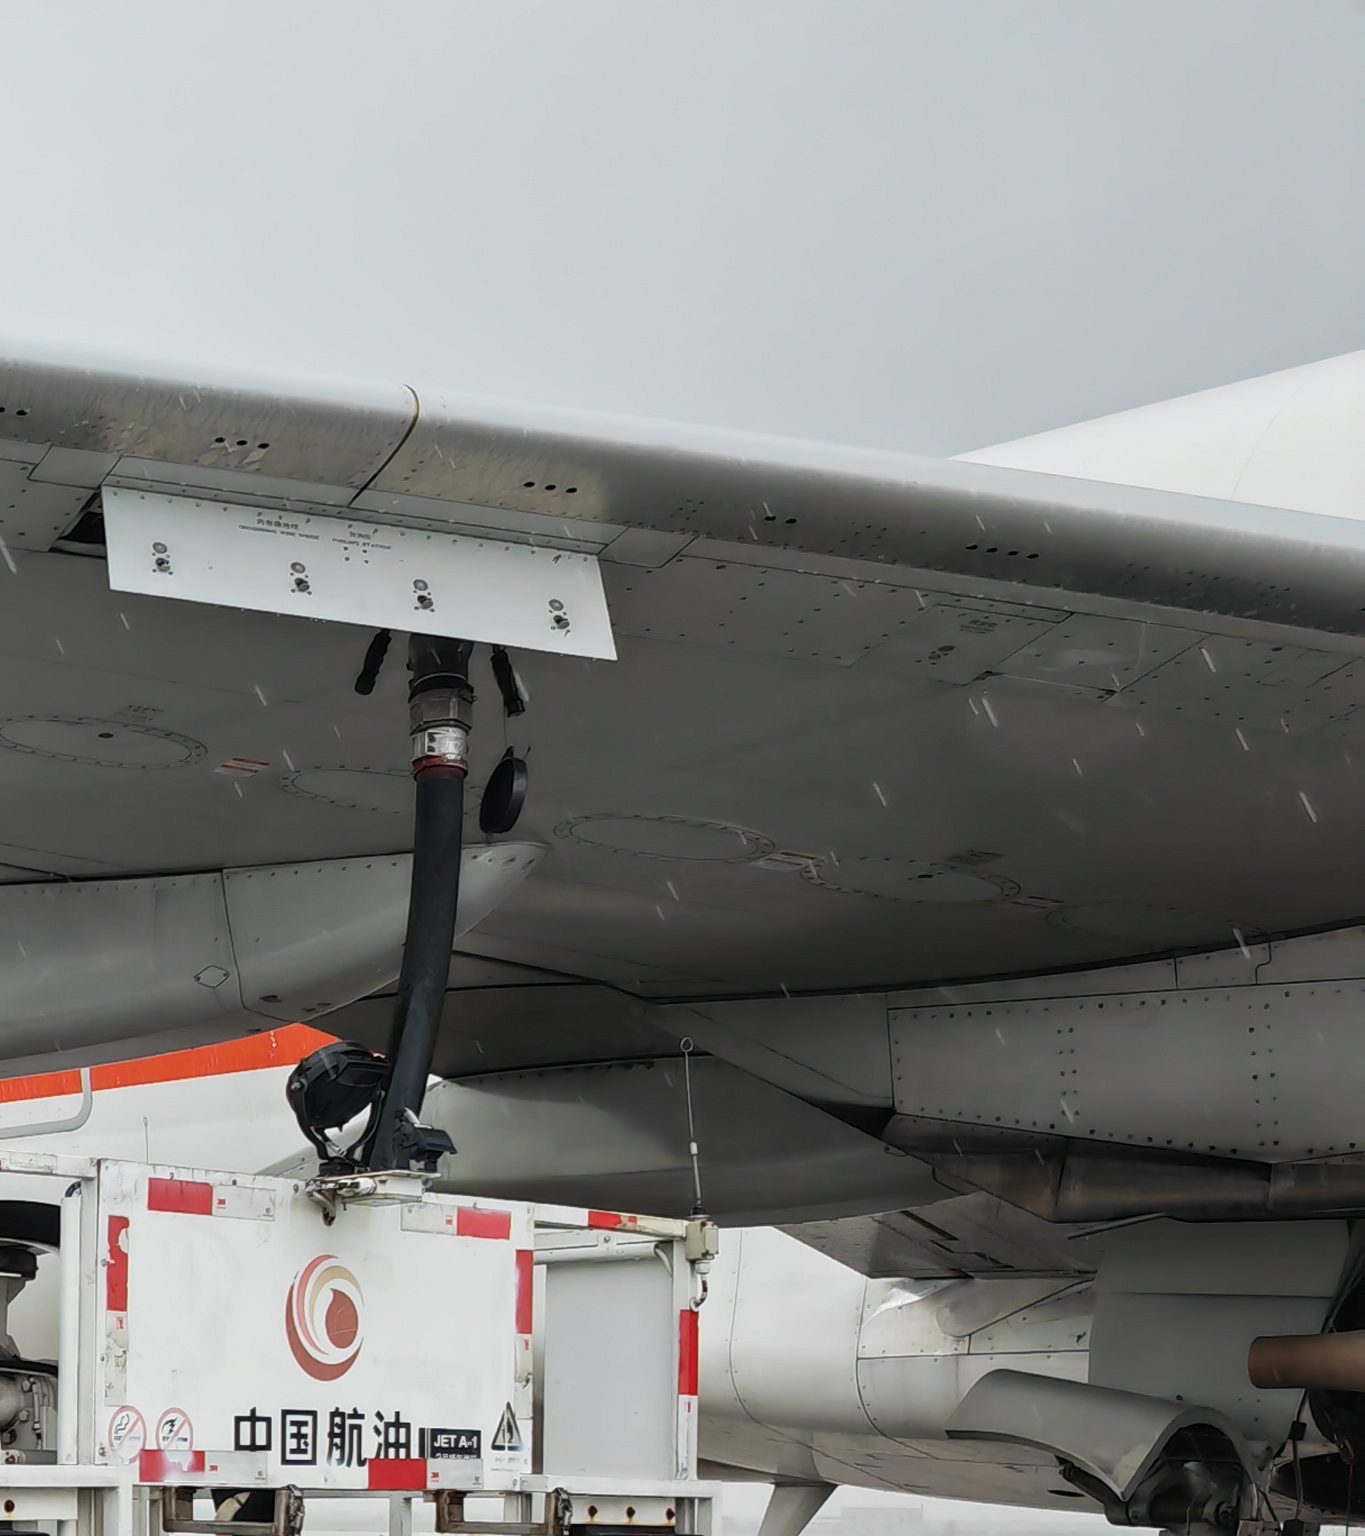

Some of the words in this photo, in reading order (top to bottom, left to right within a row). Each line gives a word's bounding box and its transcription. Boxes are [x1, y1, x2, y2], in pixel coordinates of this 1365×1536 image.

[233, 1406, 411, 1468] 中国航油
[434, 1434, 456, 1449] JET
[458, 1435, 478, 1449] A-1
